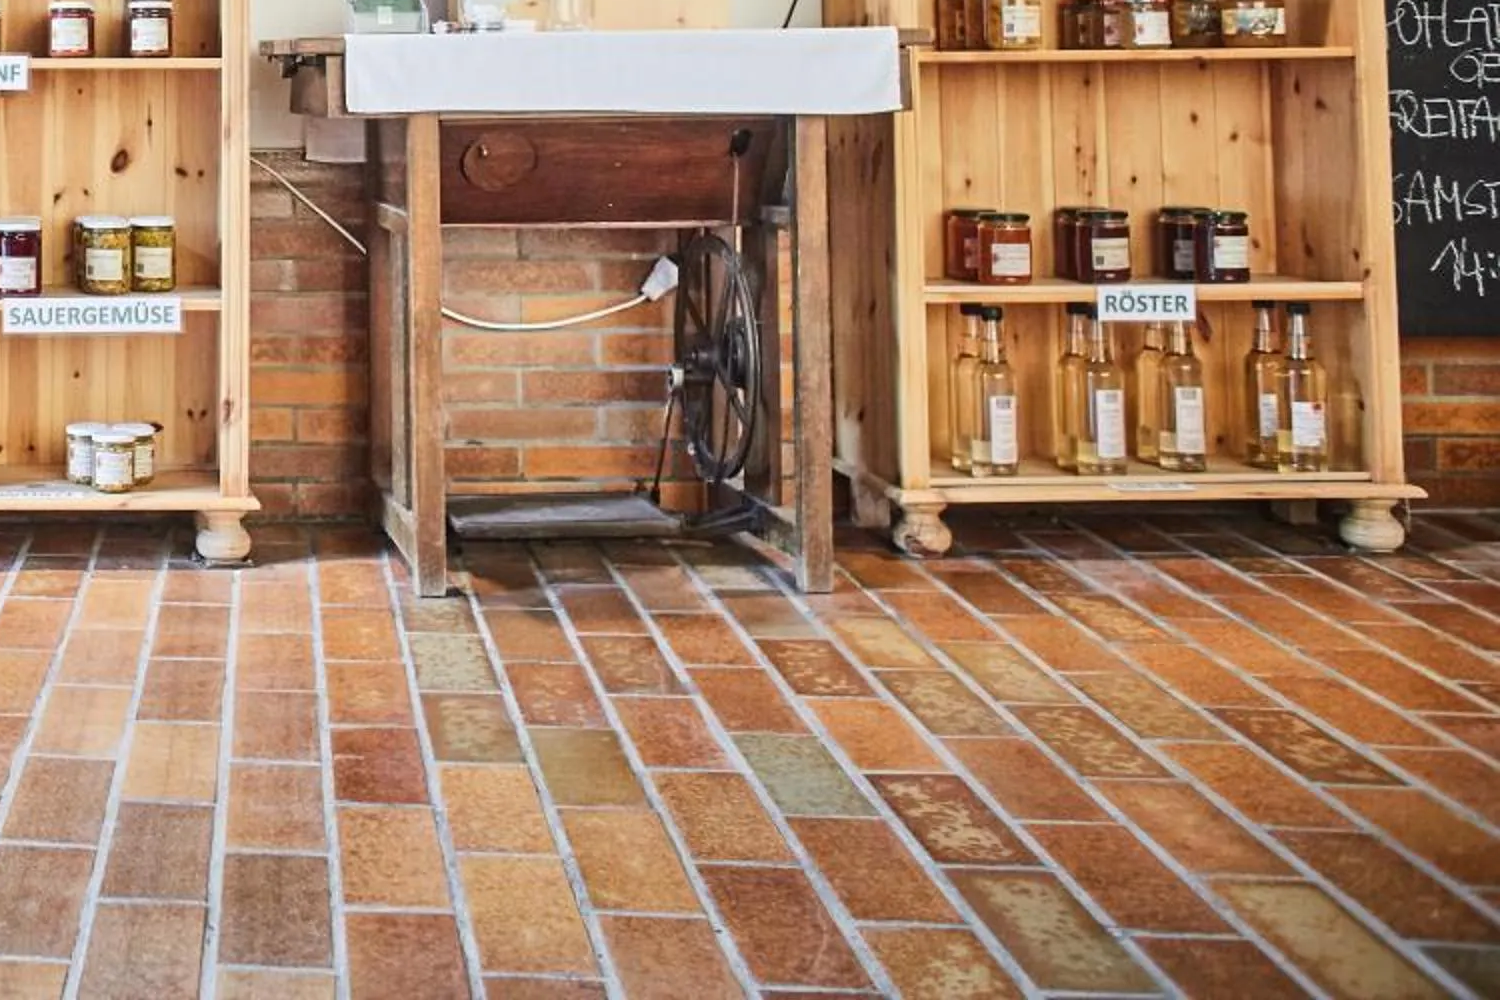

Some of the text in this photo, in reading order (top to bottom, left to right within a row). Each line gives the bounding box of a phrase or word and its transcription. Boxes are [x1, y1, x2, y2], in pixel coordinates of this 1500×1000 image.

[1388, 88, 1500, 142] REITA
[7, 301, 176, 326] SAUERGEMÜSE
[1104, 289, 1189, 313] RÖSTER
